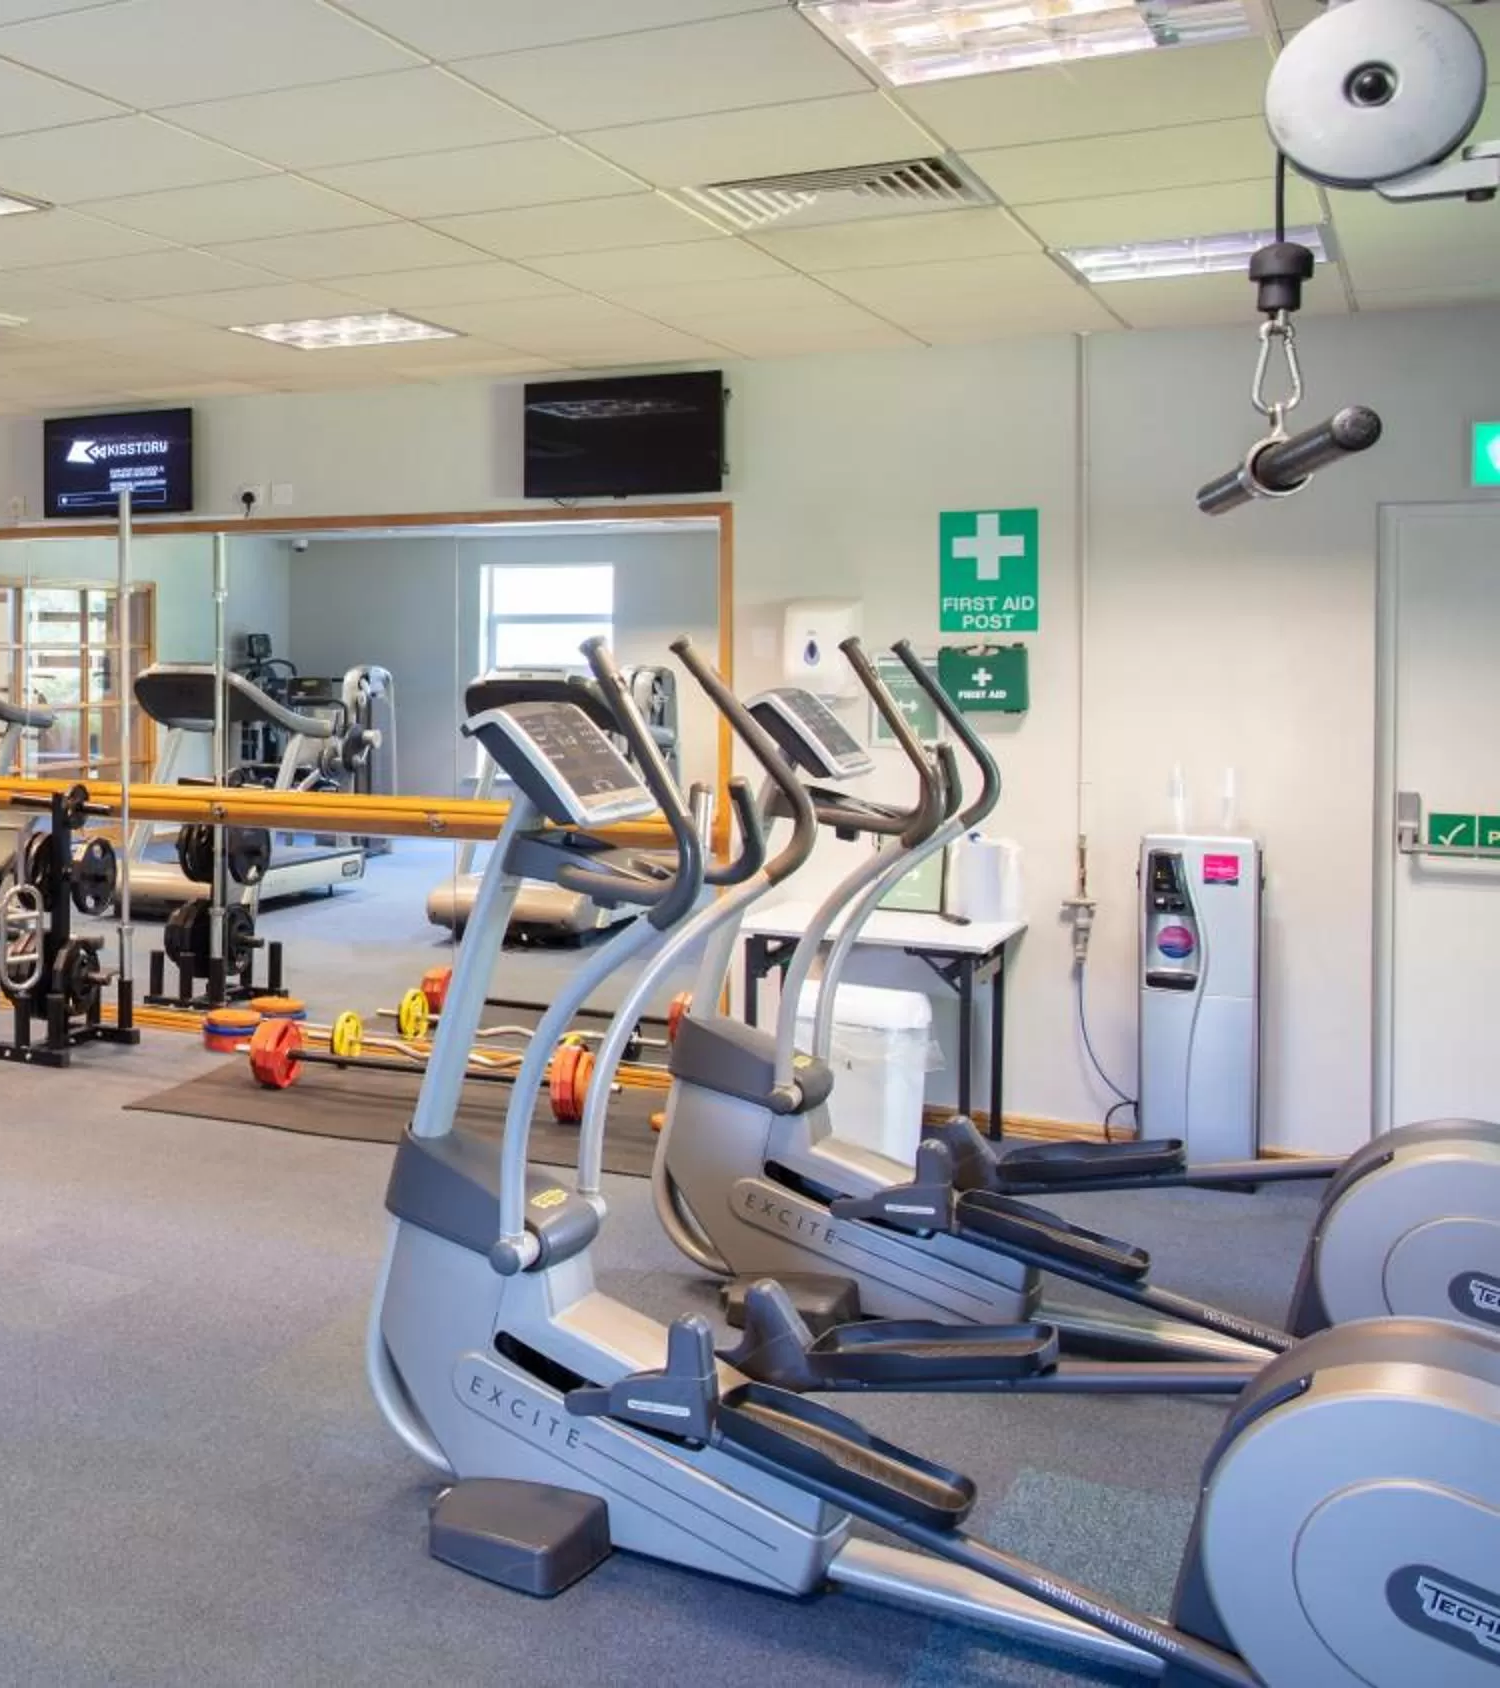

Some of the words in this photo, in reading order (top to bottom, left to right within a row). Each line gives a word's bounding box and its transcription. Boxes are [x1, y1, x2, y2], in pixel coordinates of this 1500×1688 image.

[943, 596, 996, 611] FIRST
[1002, 595, 1035, 610] AID
[961, 614, 1016, 629] POST
[957, 689, 986, 699] FIRST
[987, 689, 1007, 699] AID
[744, 1193, 837, 1245] EXCITE
[469, 1375, 581, 1449] EXCITE
